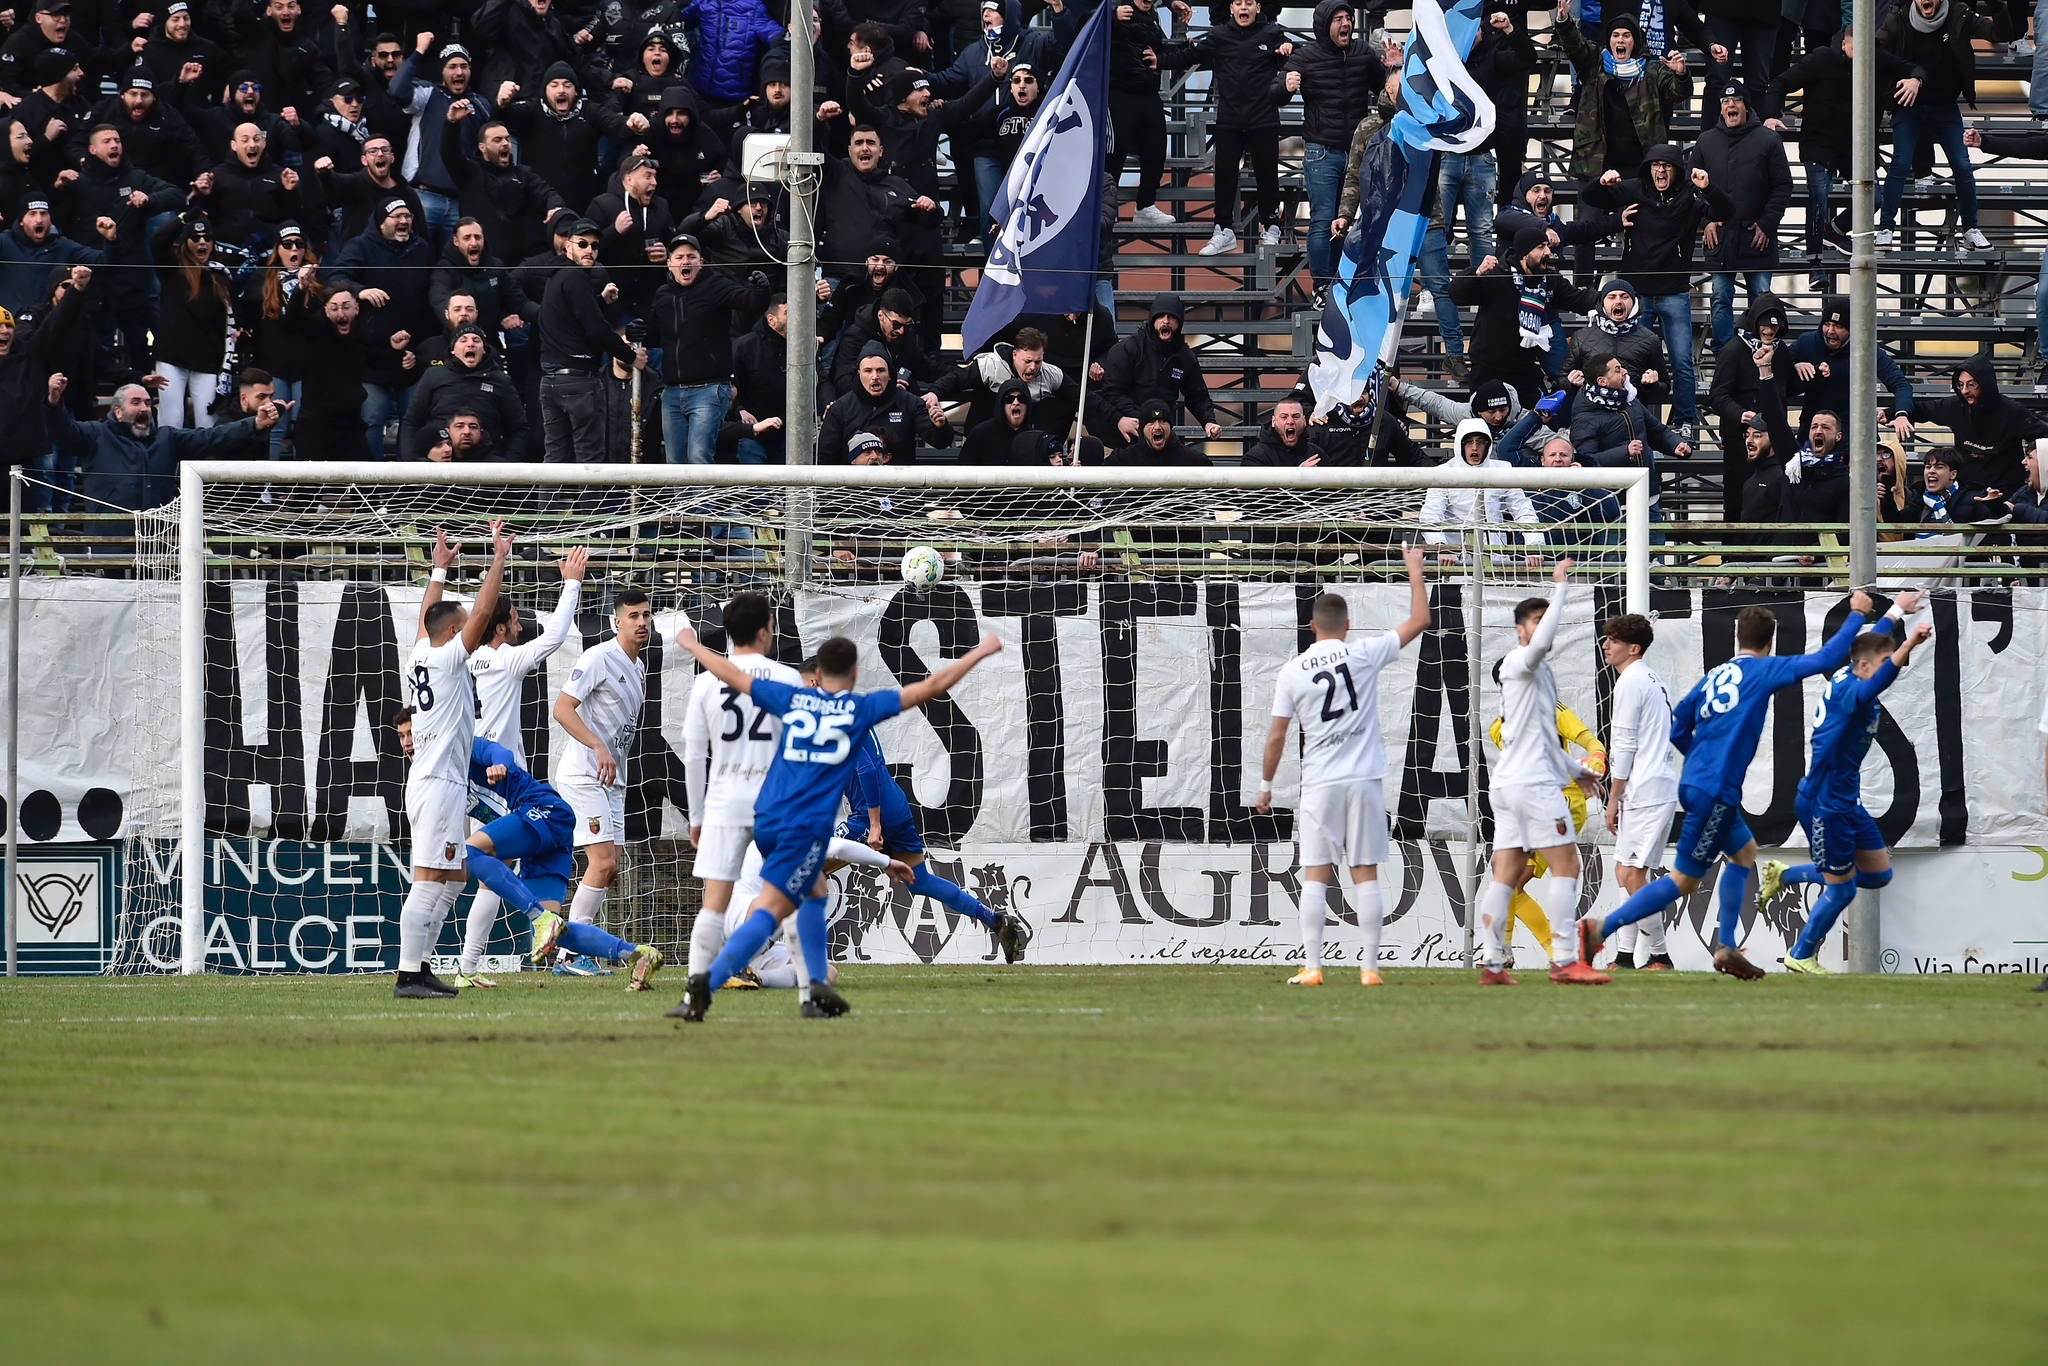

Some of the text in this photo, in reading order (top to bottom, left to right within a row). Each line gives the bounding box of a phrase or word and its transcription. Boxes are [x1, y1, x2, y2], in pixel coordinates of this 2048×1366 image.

[1301, 647, 1350, 671] CASOLI
[1311, 662, 1359, 723] 21
[1700, 662, 1743, 719] 13
[782, 709, 856, 766] 25
[142, 915, 386, 970] CALCE
[1914, 957, 1953, 974] Via
